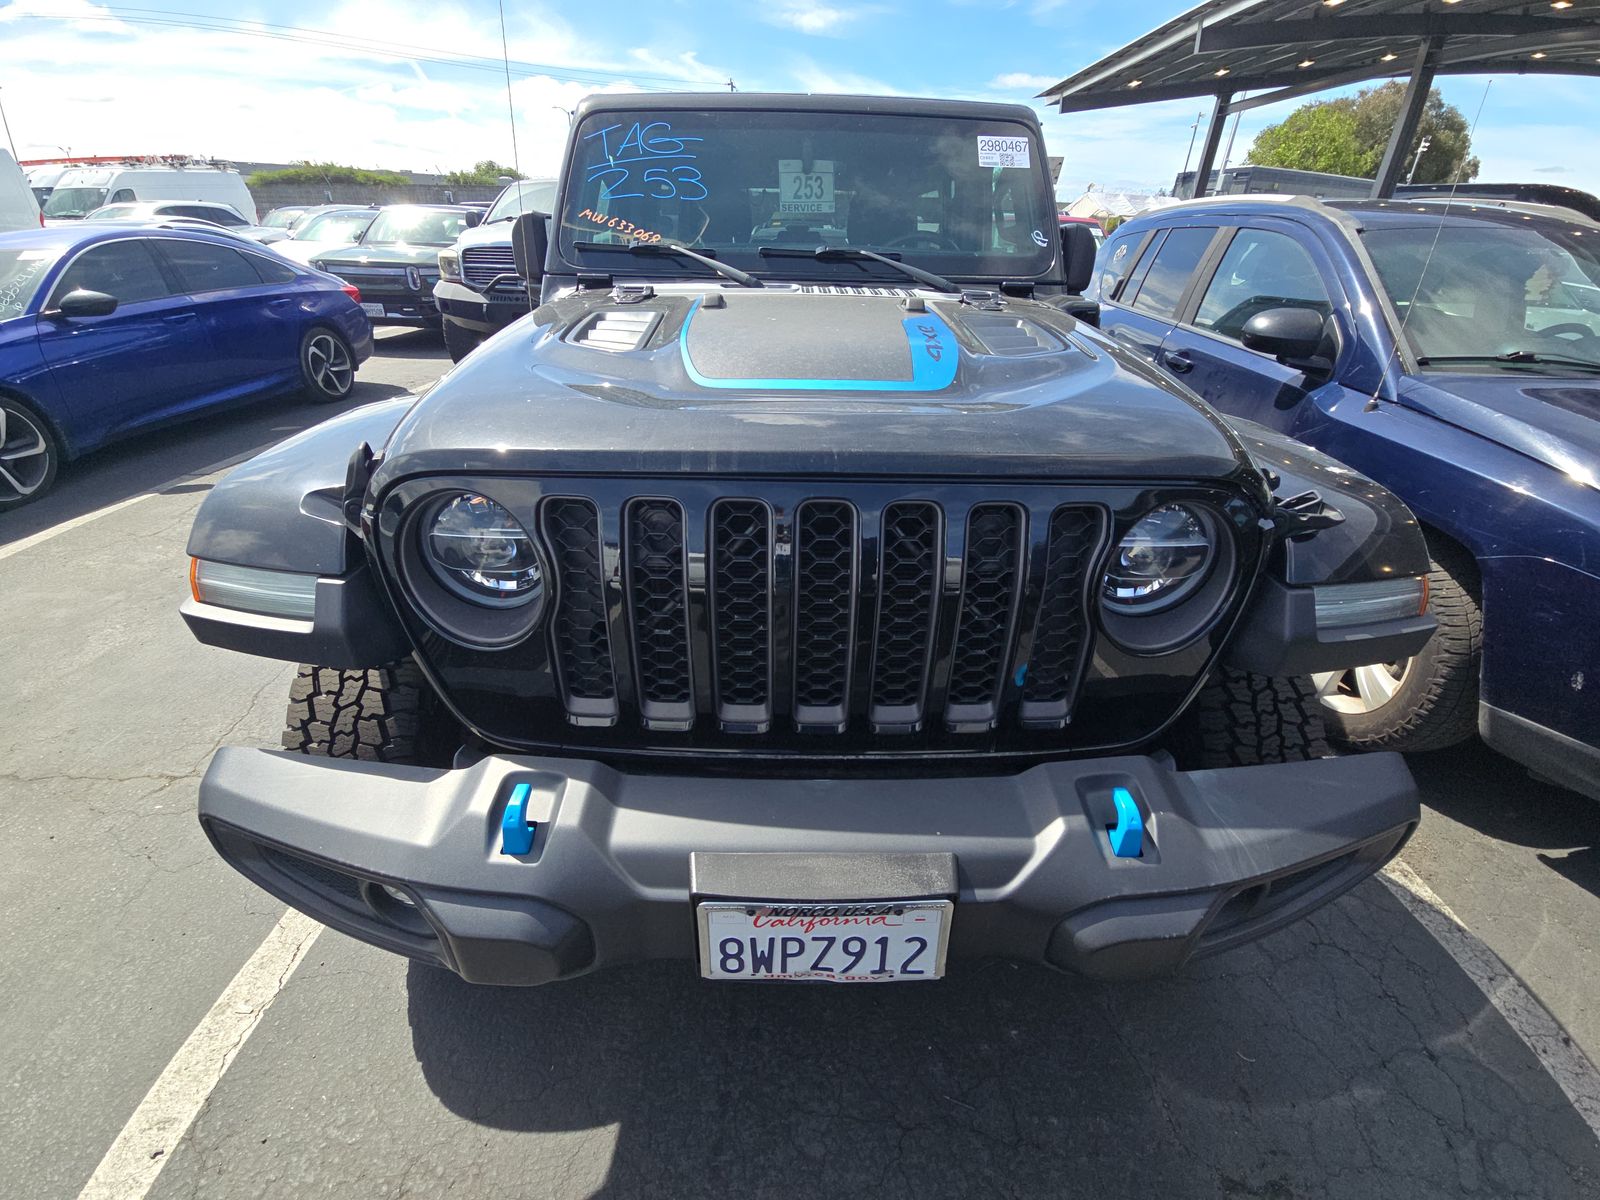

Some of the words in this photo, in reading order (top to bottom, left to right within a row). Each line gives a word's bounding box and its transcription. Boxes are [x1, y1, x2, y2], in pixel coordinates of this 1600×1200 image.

[584, 122, 704, 159] TAG
[980, 139, 1028, 152] 2980467
[588, 165, 708, 200] 253
[793, 175, 824, 200] 253
[781, 203, 823, 212] SERVICE
[767, 904, 835, 917] NORCO
[753, 914, 903, 934] California
[719, 936, 928, 974] 8WPZ912
